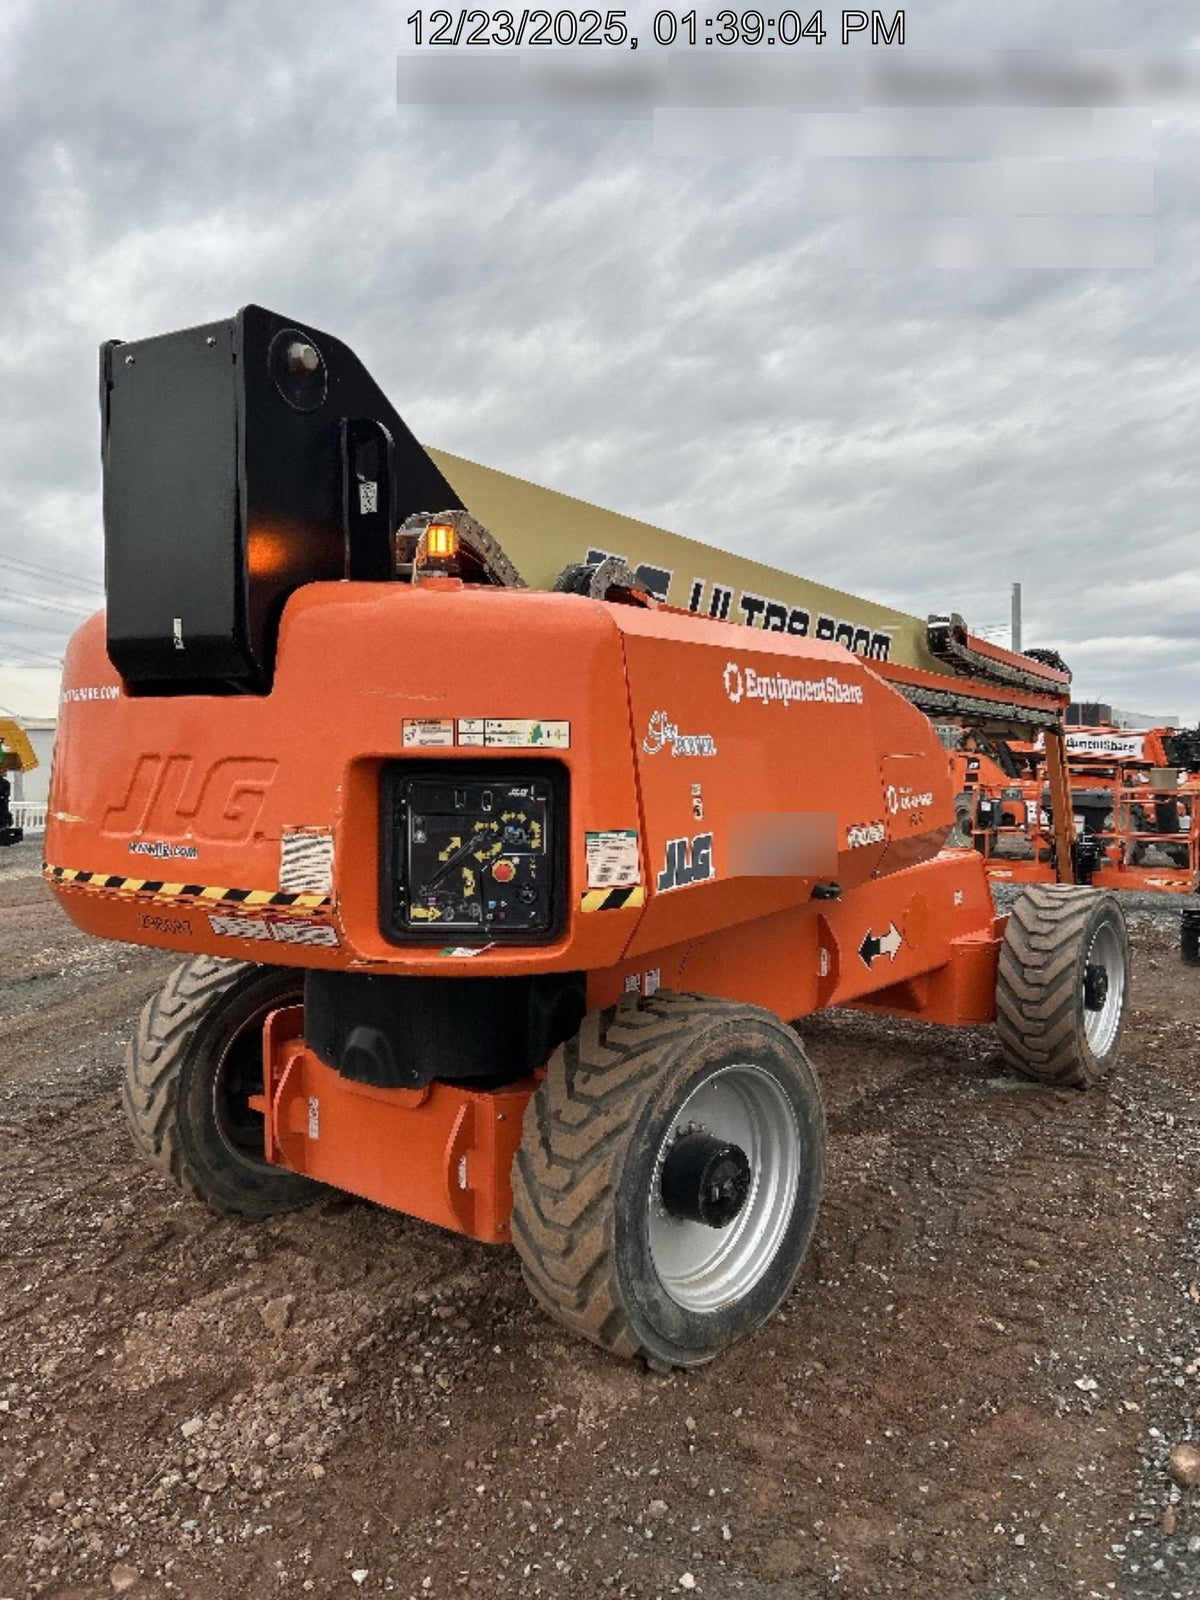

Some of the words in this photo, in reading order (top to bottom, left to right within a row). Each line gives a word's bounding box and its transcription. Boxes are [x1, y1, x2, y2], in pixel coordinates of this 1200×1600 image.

[744, 667, 863, 706] EquipmentShare
[100, 754, 278, 846] JLG
[657, 832, 714, 893] JLG
